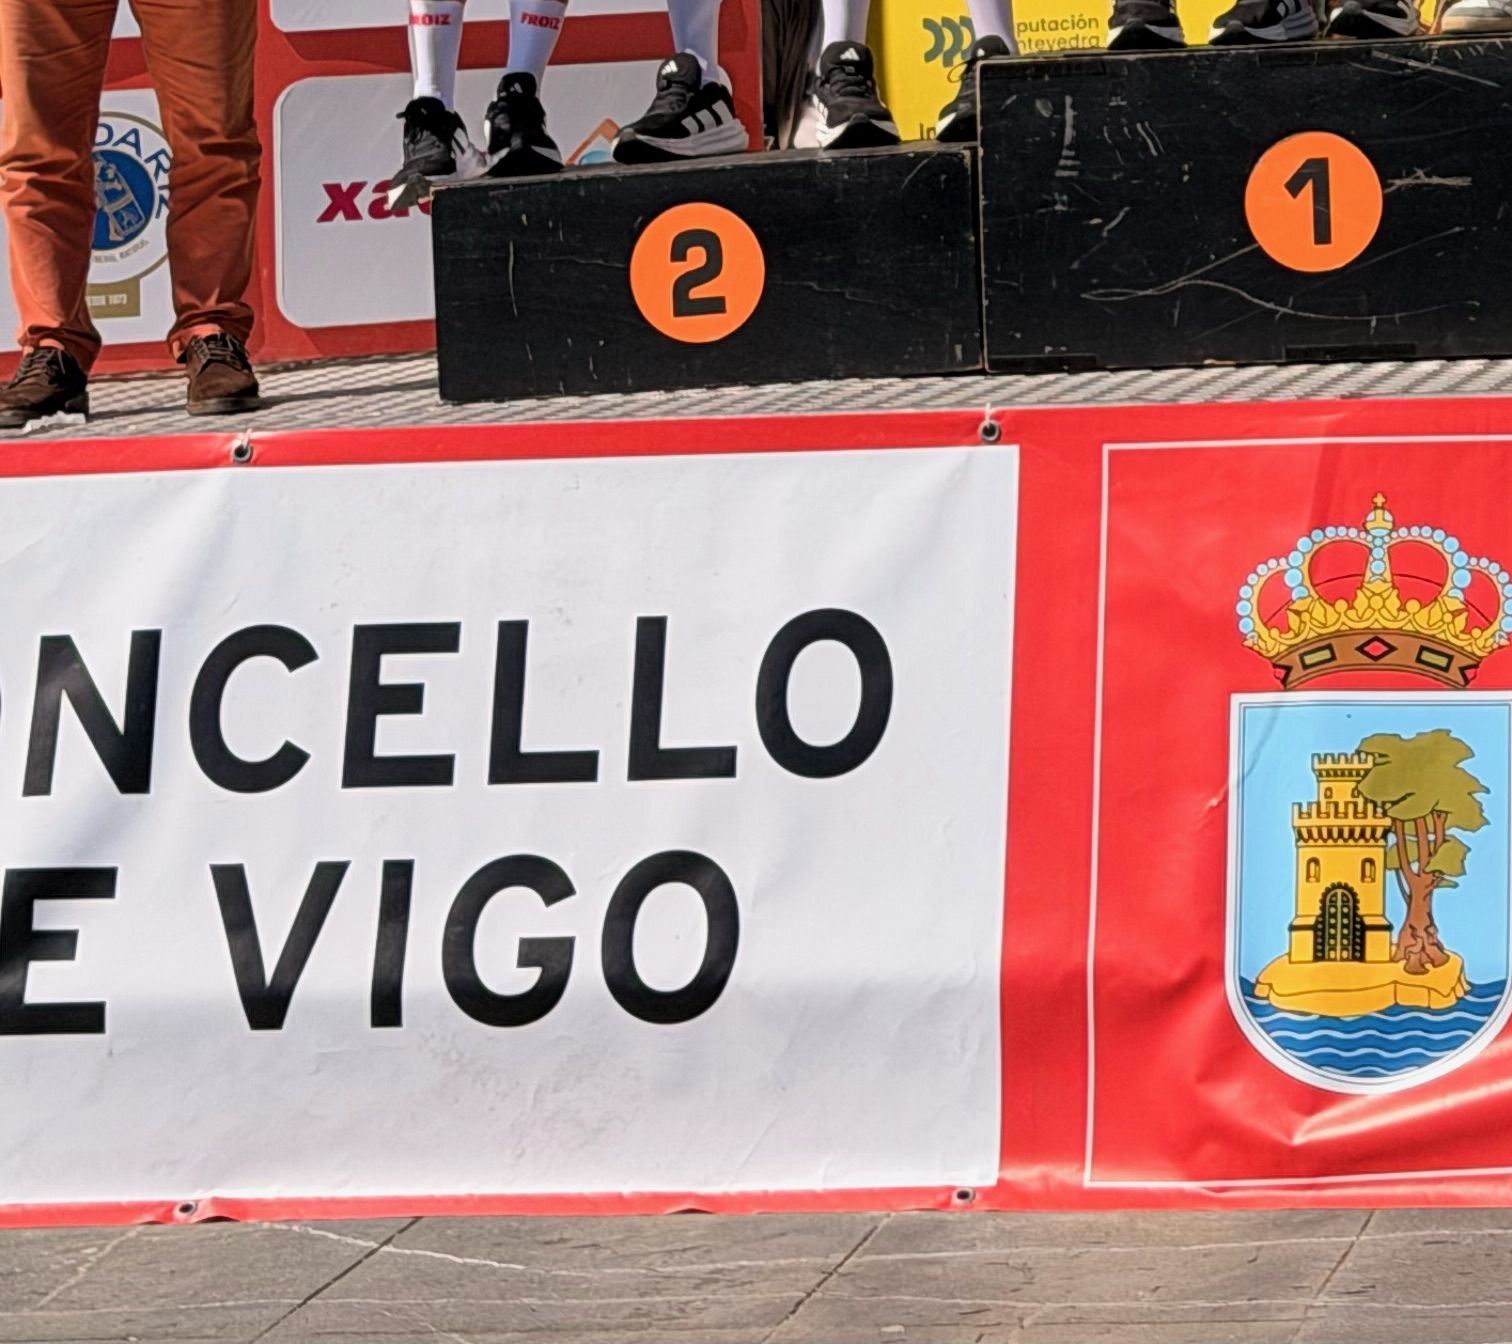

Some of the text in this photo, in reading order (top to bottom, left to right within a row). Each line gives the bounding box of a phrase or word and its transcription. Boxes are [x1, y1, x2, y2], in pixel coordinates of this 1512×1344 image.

[1017, 13, 1099, 37] putación
[1283, 156, 1334, 248] 1
[667, 227, 730, 318] 2
[208, 849, 741, 1032] VIGO
